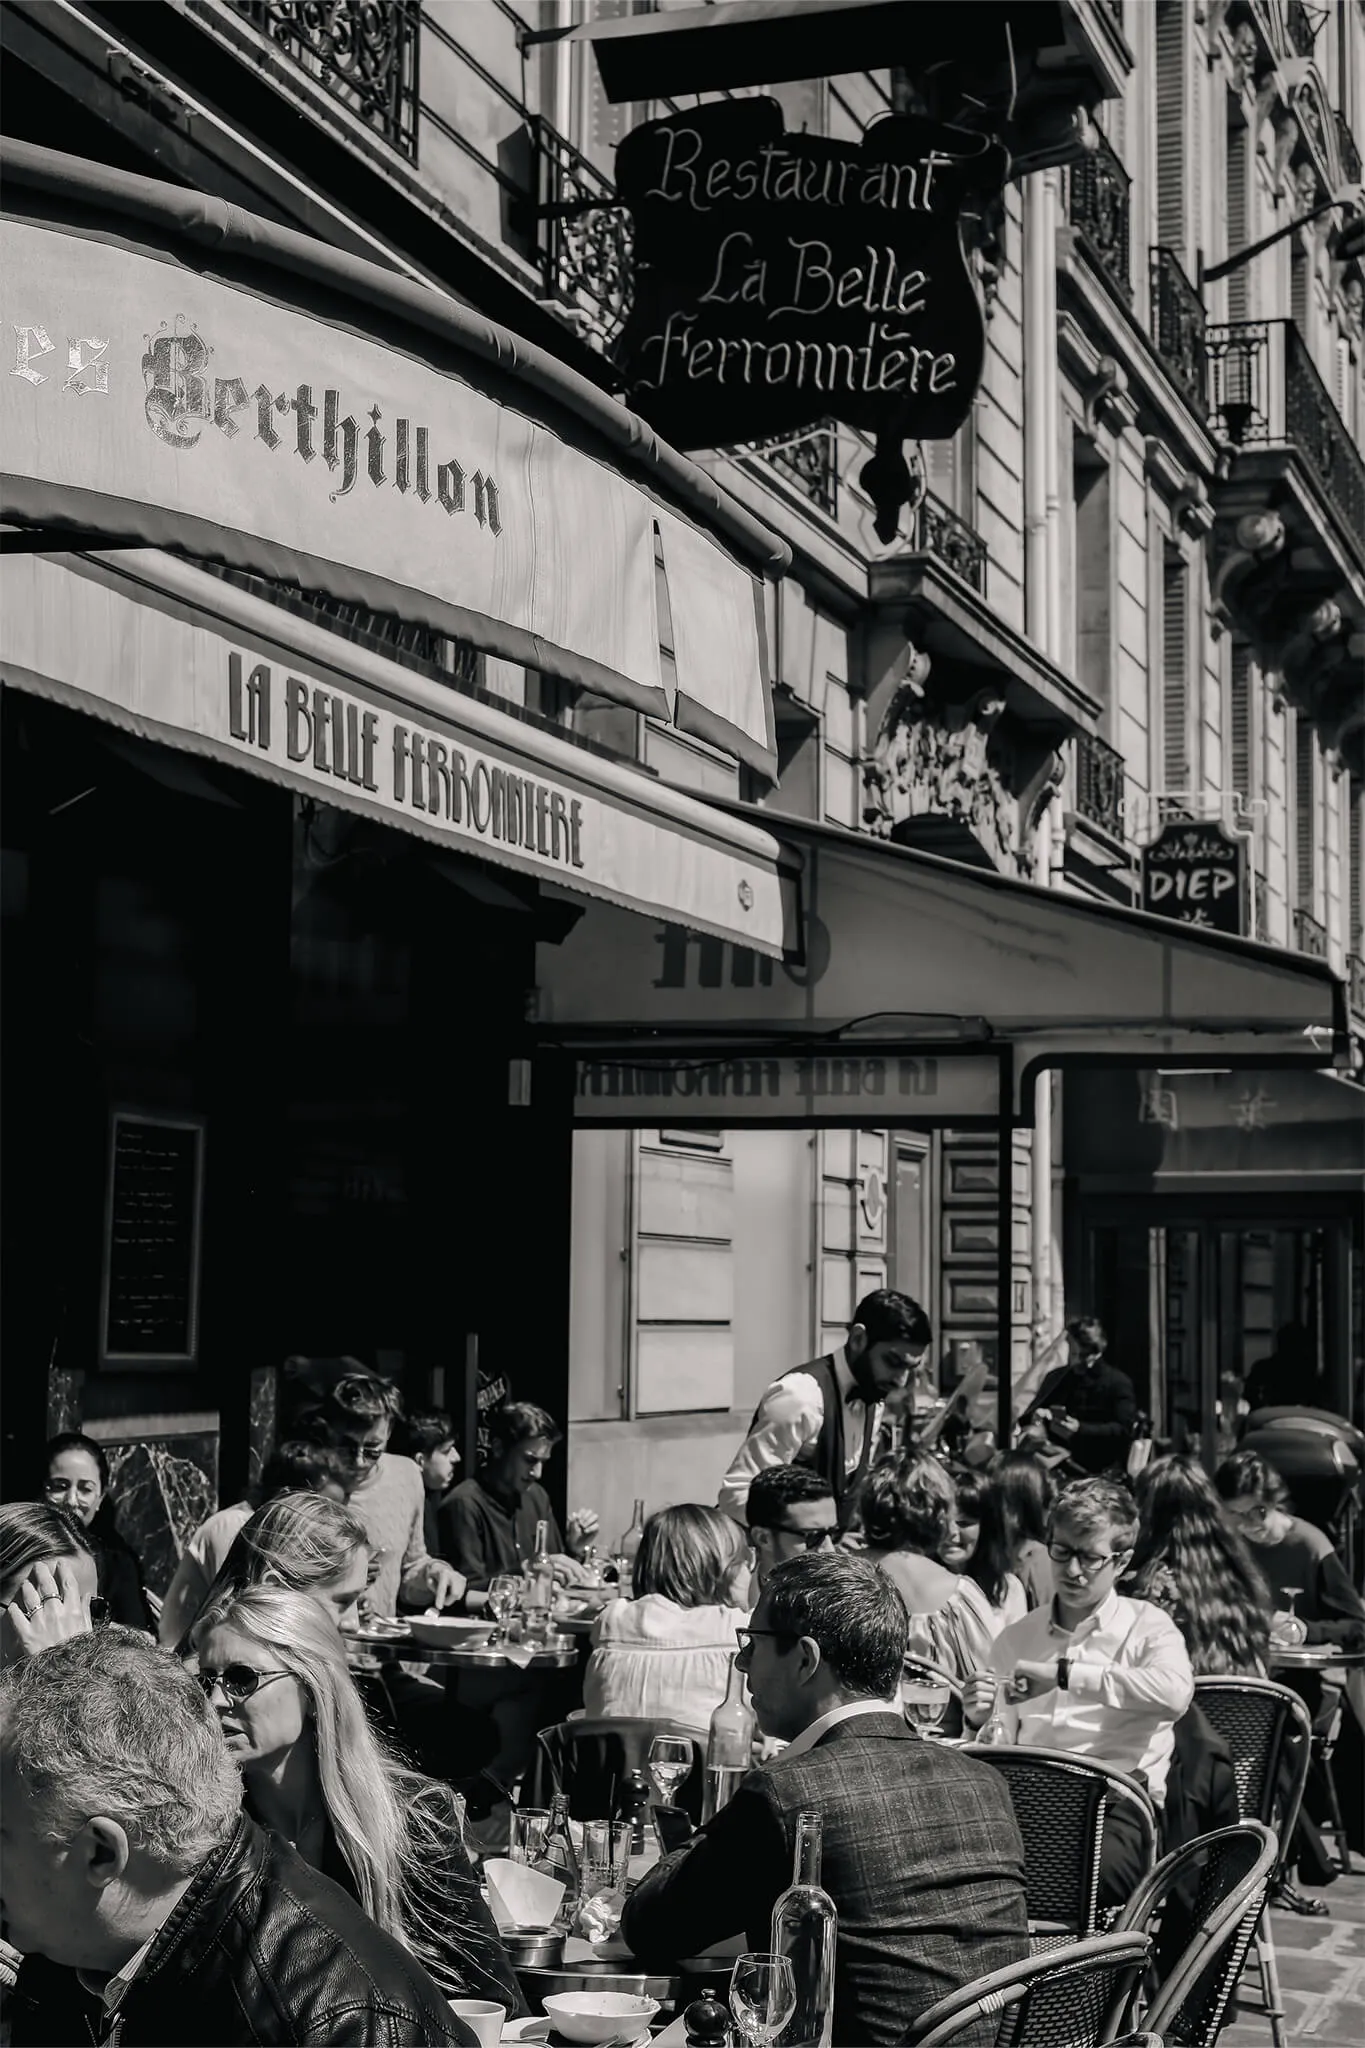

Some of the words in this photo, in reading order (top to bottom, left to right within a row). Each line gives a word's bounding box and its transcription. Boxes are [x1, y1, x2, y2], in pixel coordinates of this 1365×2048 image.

[645, 127, 953, 212] Restaurant
[699, 231, 767, 306] La
[768, 237, 927, 319] Belle
[141, 313, 503, 538] Berthillon
[229, 651, 271, 751] LA
[285, 676, 380, 793] BELLE
[392, 724, 585, 869] FERRONNIERE
[1148, 868, 1237, 901] DIEP
